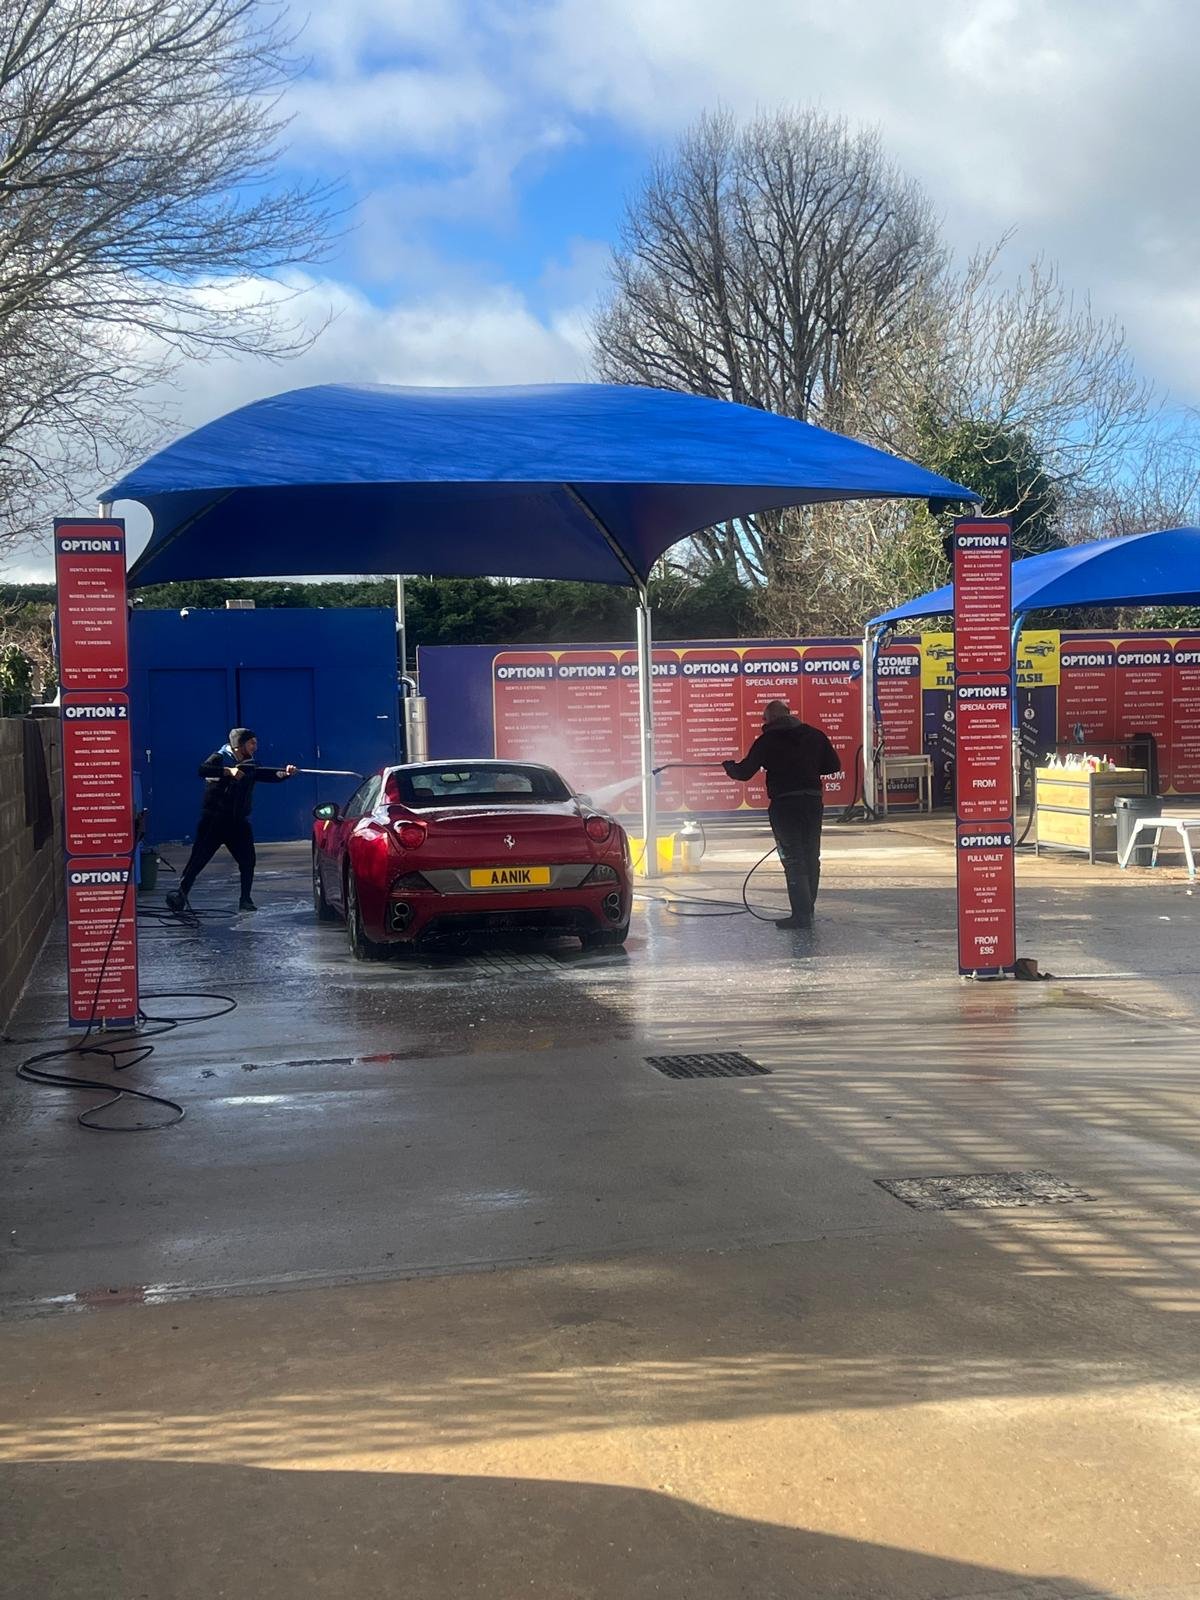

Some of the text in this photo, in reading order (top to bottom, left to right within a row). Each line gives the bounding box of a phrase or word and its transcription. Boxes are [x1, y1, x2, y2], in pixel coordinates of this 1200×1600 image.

[61, 540, 120, 551] OPTION 1
[958, 536, 1007, 547] OPTION 4
[878, 657, 919, 666] STOMER
[1062, 655, 1112, 666] OPTION 1
[1118, 654, 1170, 665] OPTION 2
[1175, 653, 1200, 663] OPTI
[559, 666, 616, 677] OPTION 2
[622, 665, 677, 676] OPON 3
[683, 664, 738, 674] OPTION 4
[744, 662, 798, 673] OPTION 5
[805, 660, 860, 672] OPTION 6
[498, 667, 553, 678] OPTION 1
[959, 687, 1007, 697] OPTION 5
[66, 706, 127, 718] OPTION 2
[825, 783, 841, 792] £95
[972, 779, 996, 788] FROM
[961, 836, 1011, 846] OPTION 6
[71, 871, 129, 883] OPTION 3
[491, 870, 531, 884] AANIK
[974, 936, 998, 944] FROM
[980, 946, 994, 955] £95
